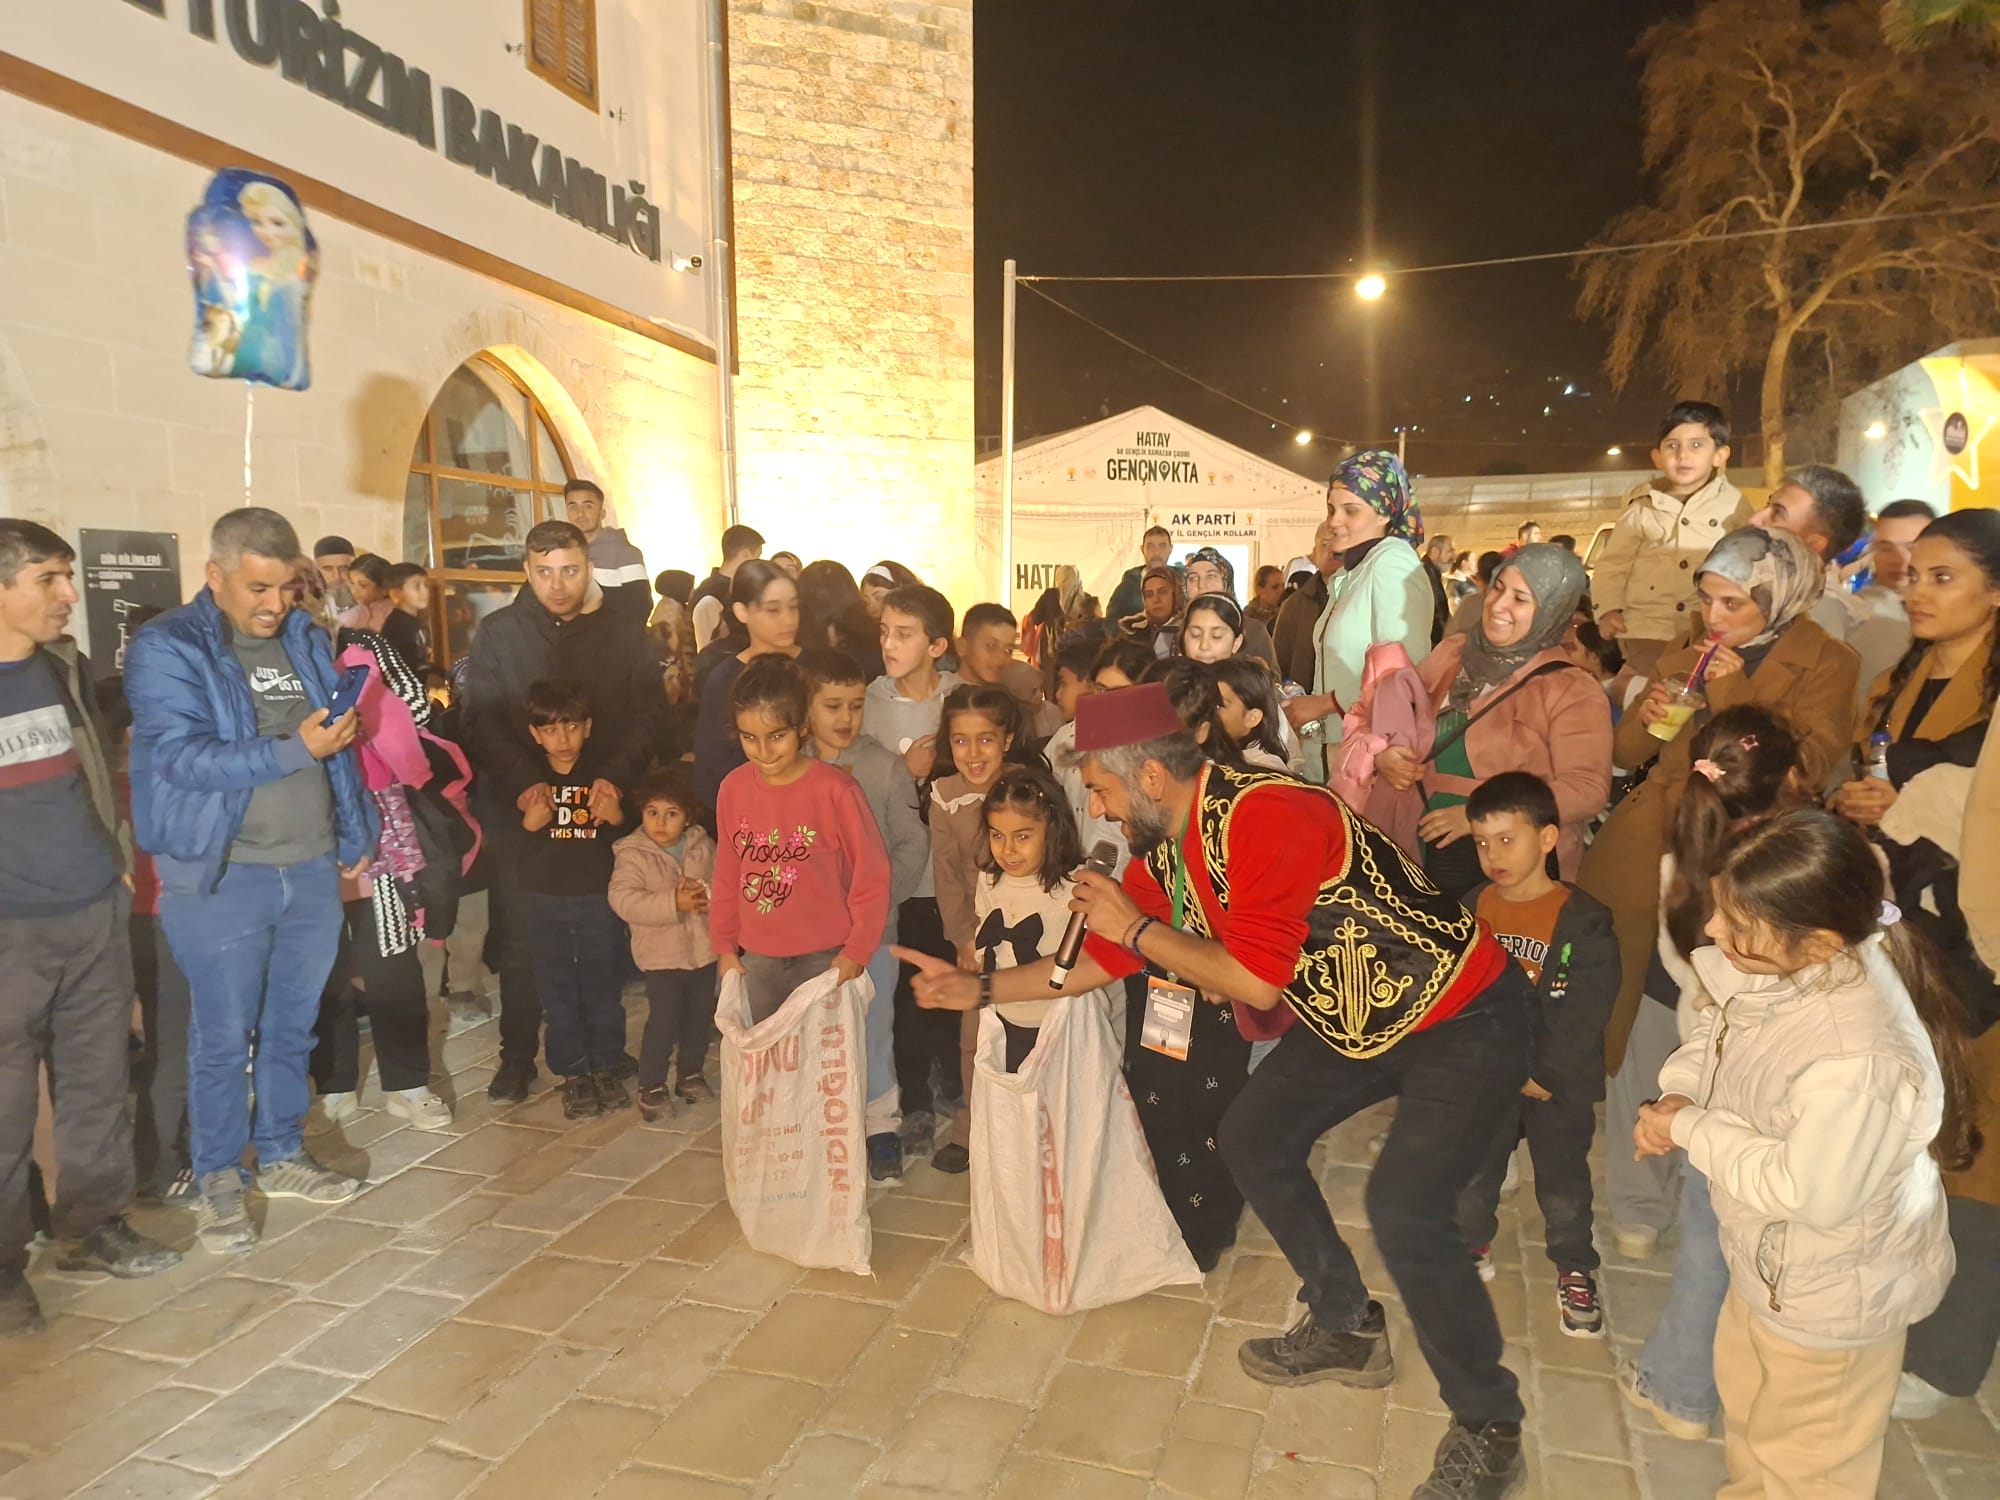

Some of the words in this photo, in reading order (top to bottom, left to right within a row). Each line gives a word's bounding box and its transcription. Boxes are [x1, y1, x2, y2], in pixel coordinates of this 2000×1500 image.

[441, 86, 662, 265] BAKANLIĞI
[1136, 431, 1171, 448] HATAY
[1171, 514, 1191, 525] AK
[1196, 511, 1236, 525] PARTİ
[1186, 529, 1222, 538] GENÇLİK
[1016, 564, 1061, 590] HAT
[551, 786, 589, 804] LET'
[550, 828, 573, 839] THIS
[573, 828, 597, 839] NOW
[732, 830, 811, 863] Choose
[742, 870, 793, 908] Joy
